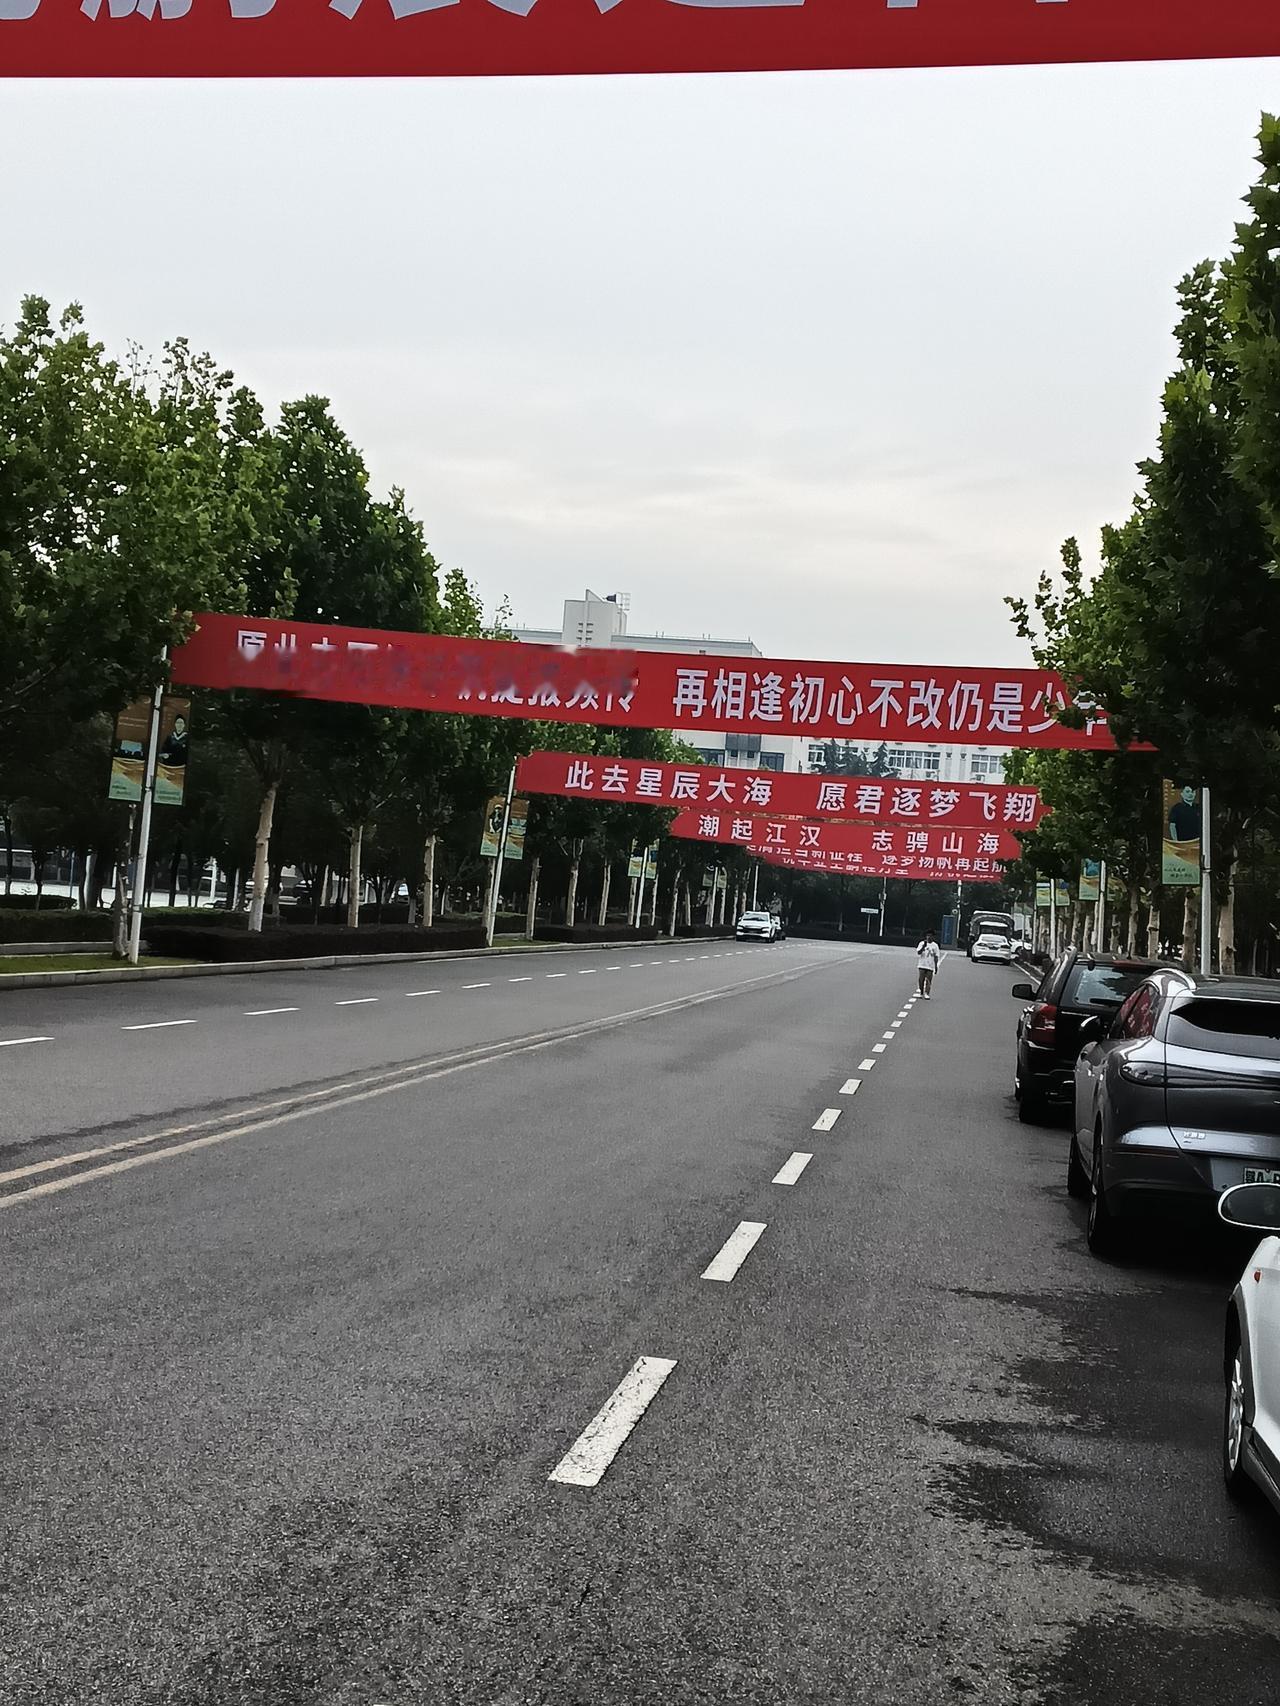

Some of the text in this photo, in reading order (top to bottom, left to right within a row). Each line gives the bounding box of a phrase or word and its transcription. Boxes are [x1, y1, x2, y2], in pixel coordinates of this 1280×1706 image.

[565, 760, 1037, 823] 此去星辰大海 愿君逐梦飞翔
[698, 814, 1000, 855] 潮起江汉 志骋山海
